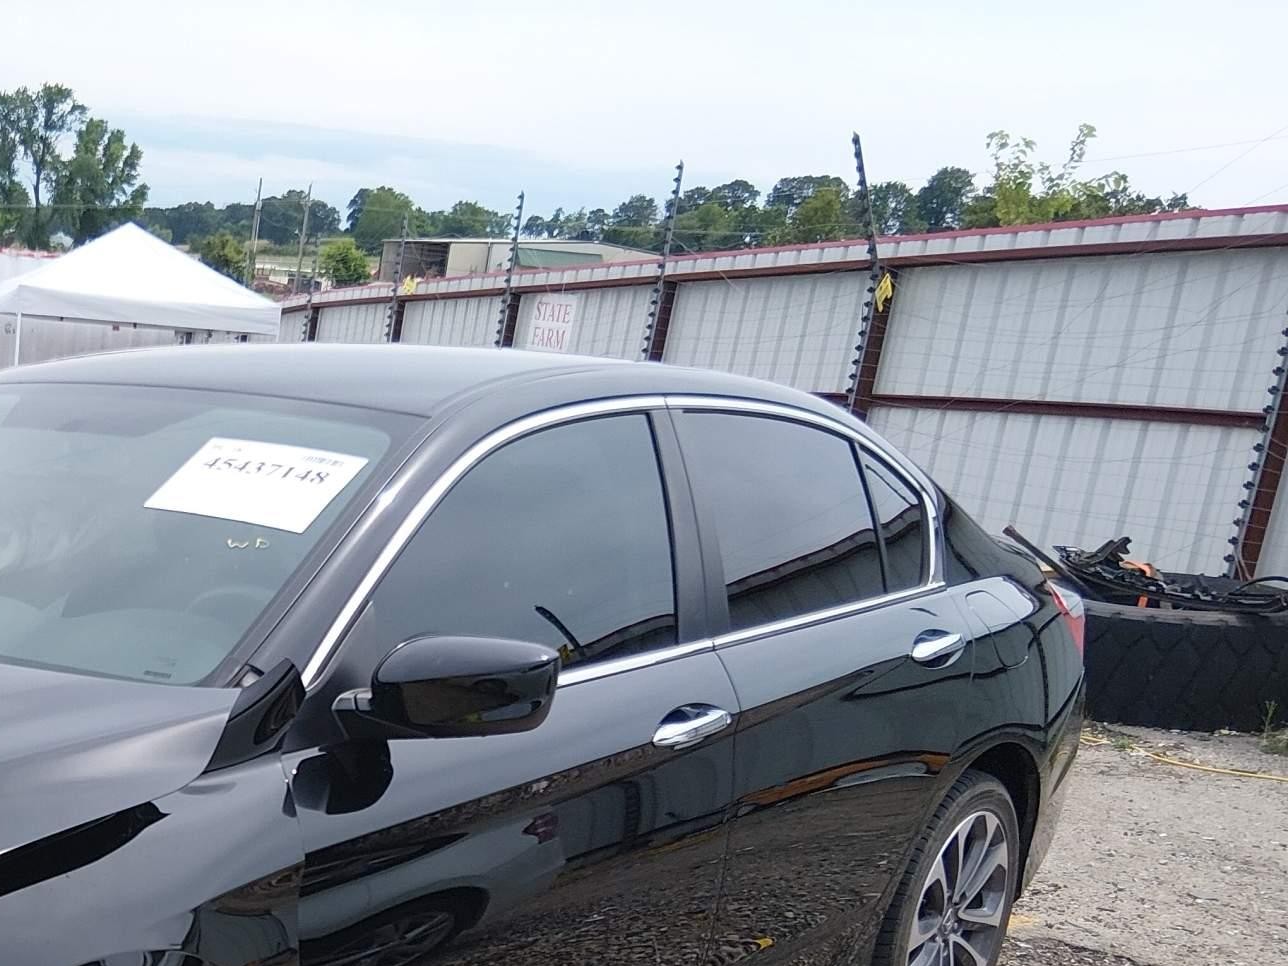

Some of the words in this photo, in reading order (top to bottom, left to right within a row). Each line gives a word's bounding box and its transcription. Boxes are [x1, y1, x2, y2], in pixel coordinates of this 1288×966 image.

[535, 301, 571, 323] STATE
[532, 326, 566, 350] FARM
[202, 455, 331, 485] 45437148
